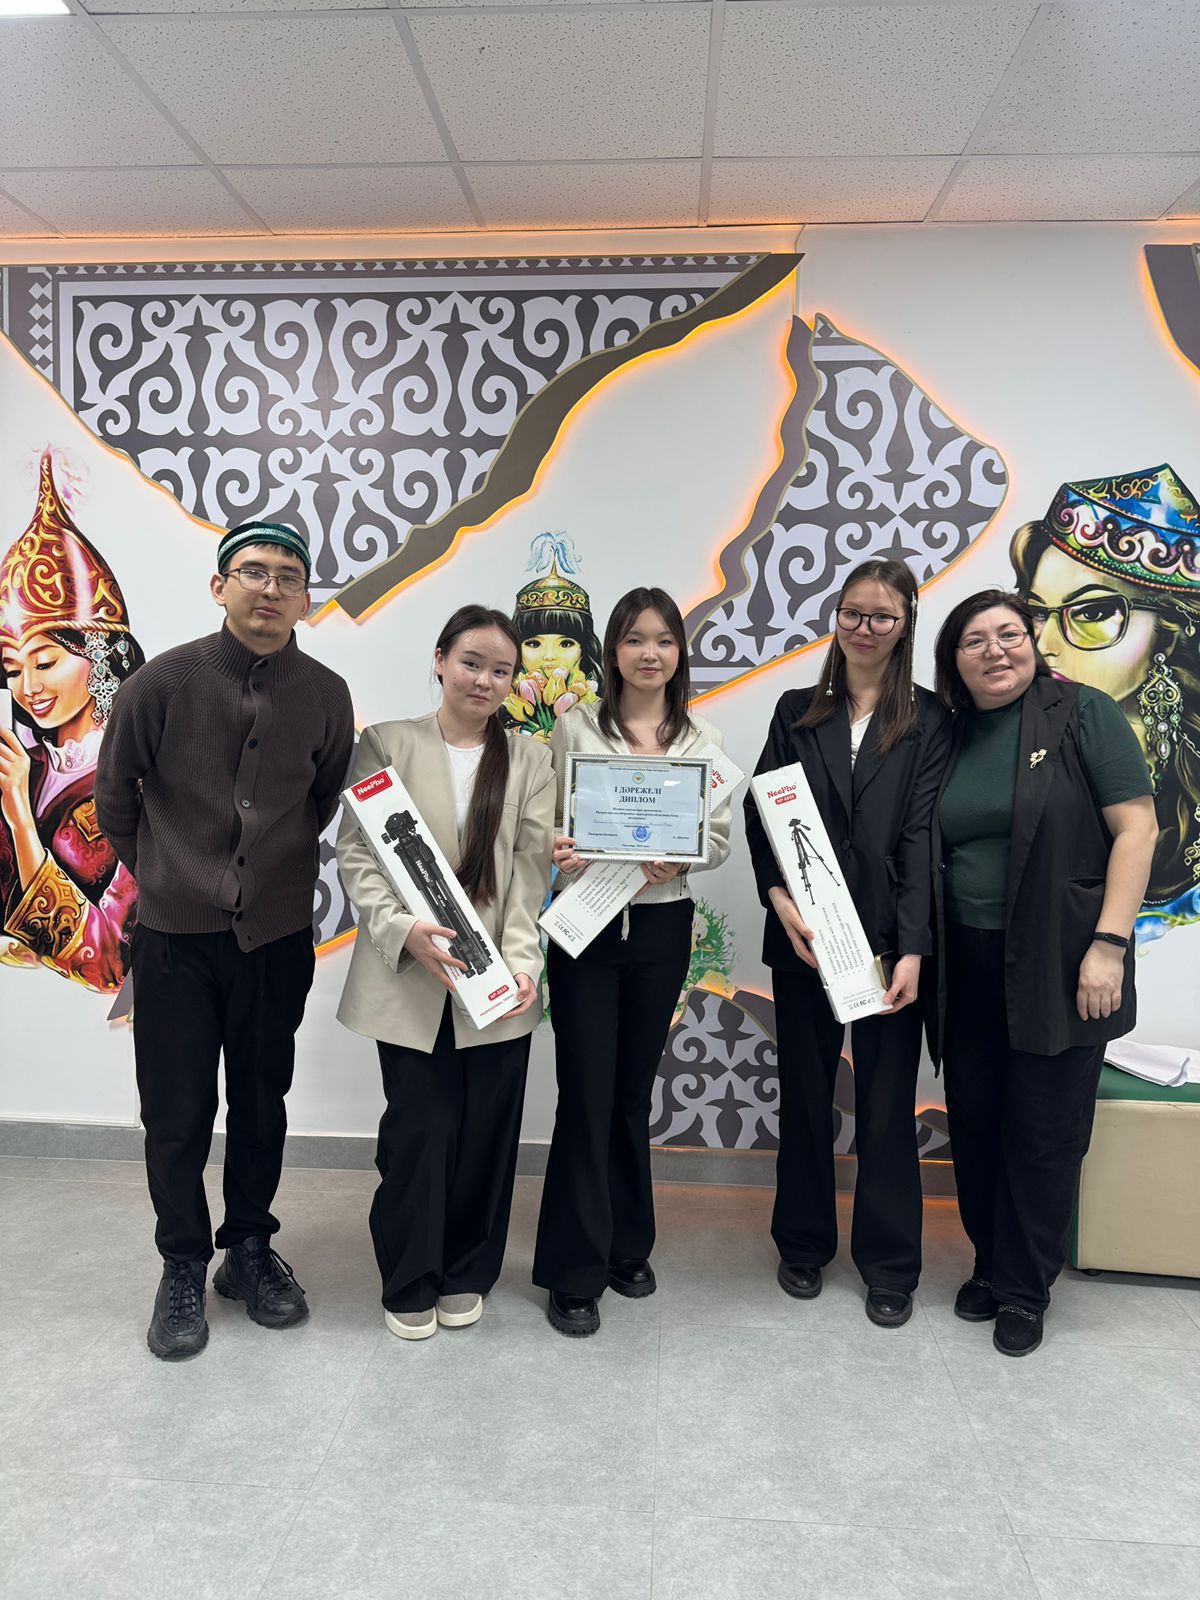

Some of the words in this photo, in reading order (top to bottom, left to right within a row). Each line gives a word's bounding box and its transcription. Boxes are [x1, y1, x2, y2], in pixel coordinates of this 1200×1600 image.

[357, 777, 385, 796] NeePho
[767, 784, 797, 799] NeePho
[618, 795, 656, 804] ДИПЛОМ
